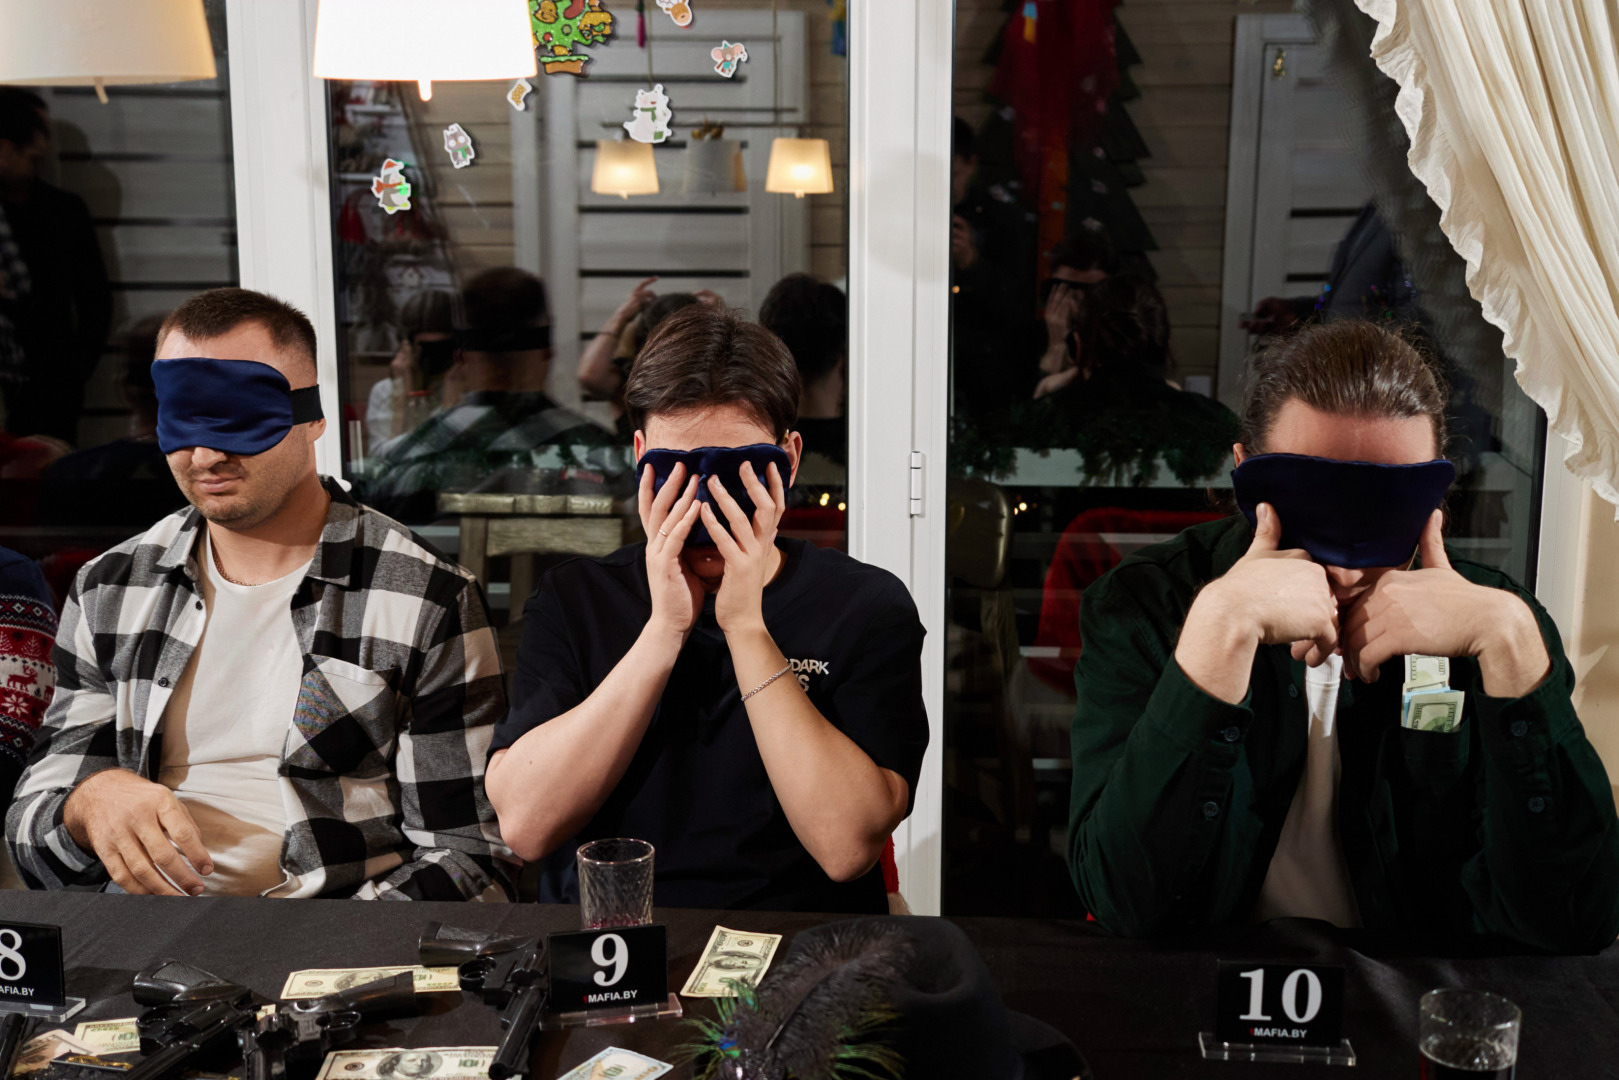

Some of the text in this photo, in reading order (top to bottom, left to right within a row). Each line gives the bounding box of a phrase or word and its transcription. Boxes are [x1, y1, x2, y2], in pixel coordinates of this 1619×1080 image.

[0, 928, 26, 981] 8
[591, 933, 629, 987] 9
[1239, 968, 1322, 1023] 10
